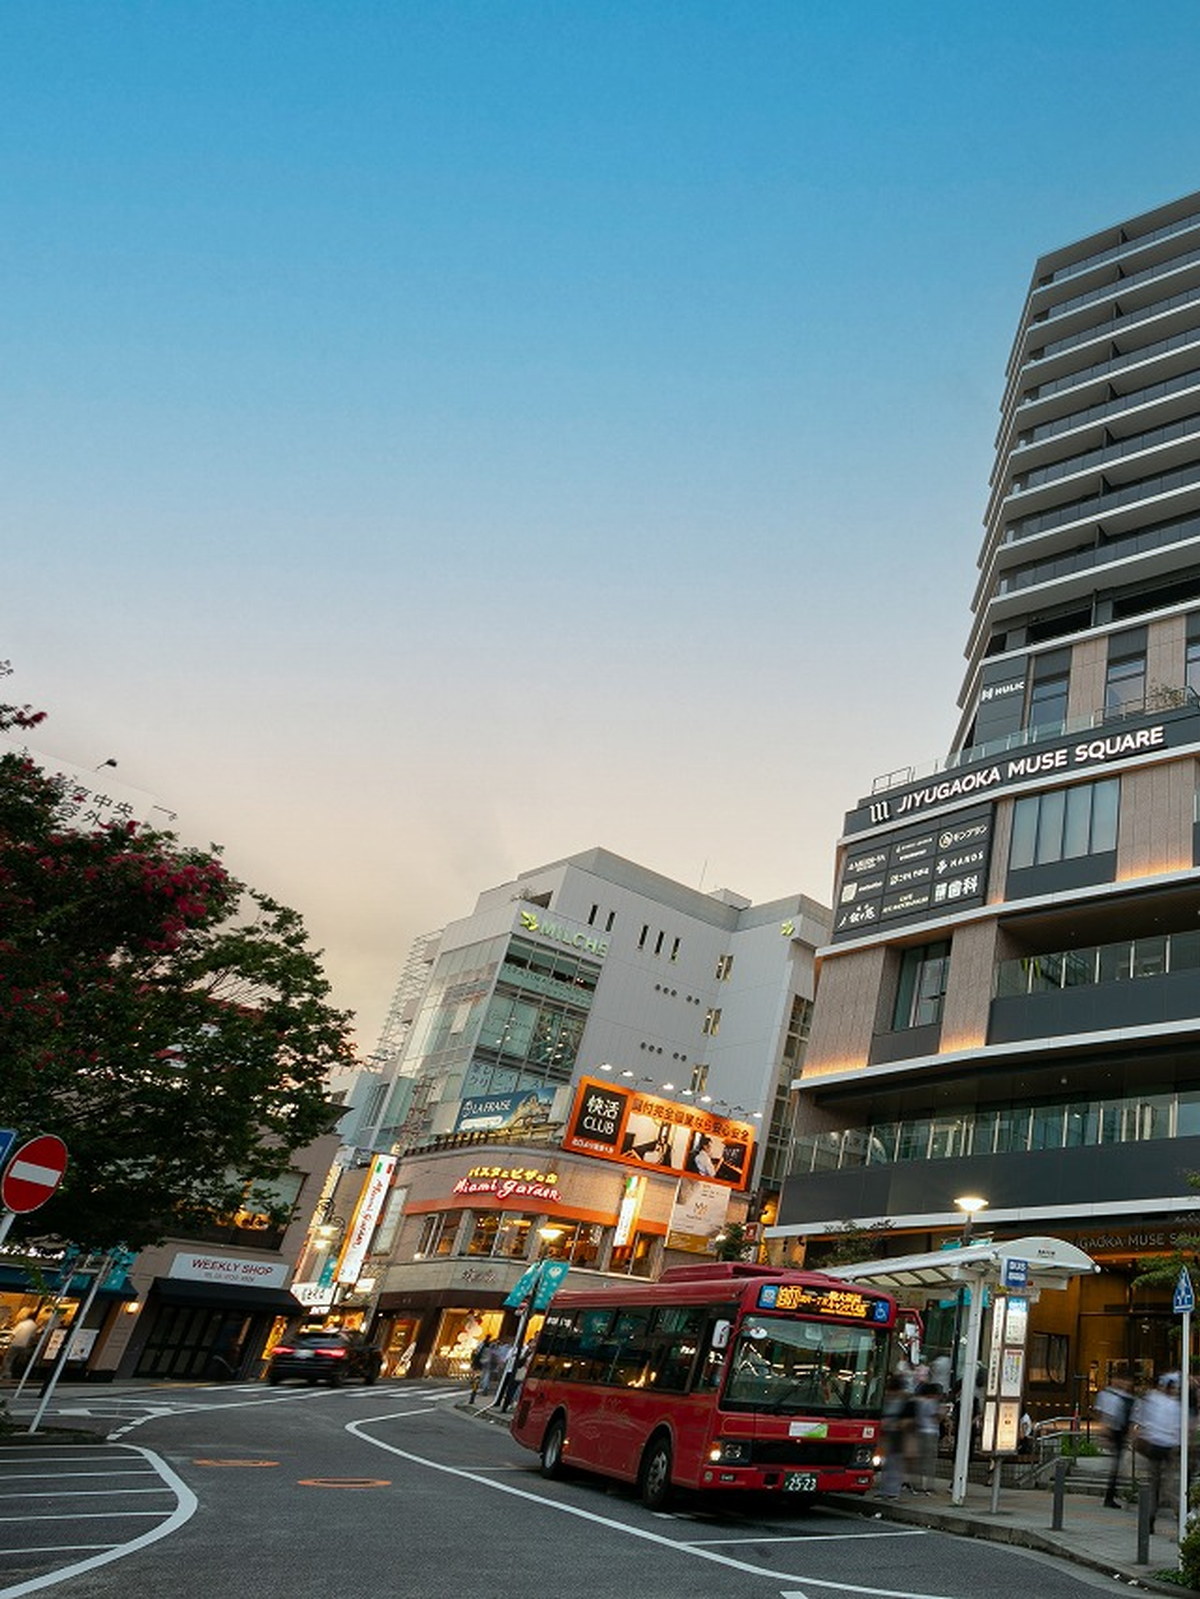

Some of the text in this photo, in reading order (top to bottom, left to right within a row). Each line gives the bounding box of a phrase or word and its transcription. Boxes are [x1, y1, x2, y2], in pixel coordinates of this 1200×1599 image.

[896, 725, 1165, 813] JIYUGAOKA MUSE SQUARE
[950, 850, 984, 867] HANDS
[582, 1115, 615, 1135] CLUB
[191, 1258, 274, 1276] WEEKLY SHOP
[788, 1478, 817, 1492] 25-23
